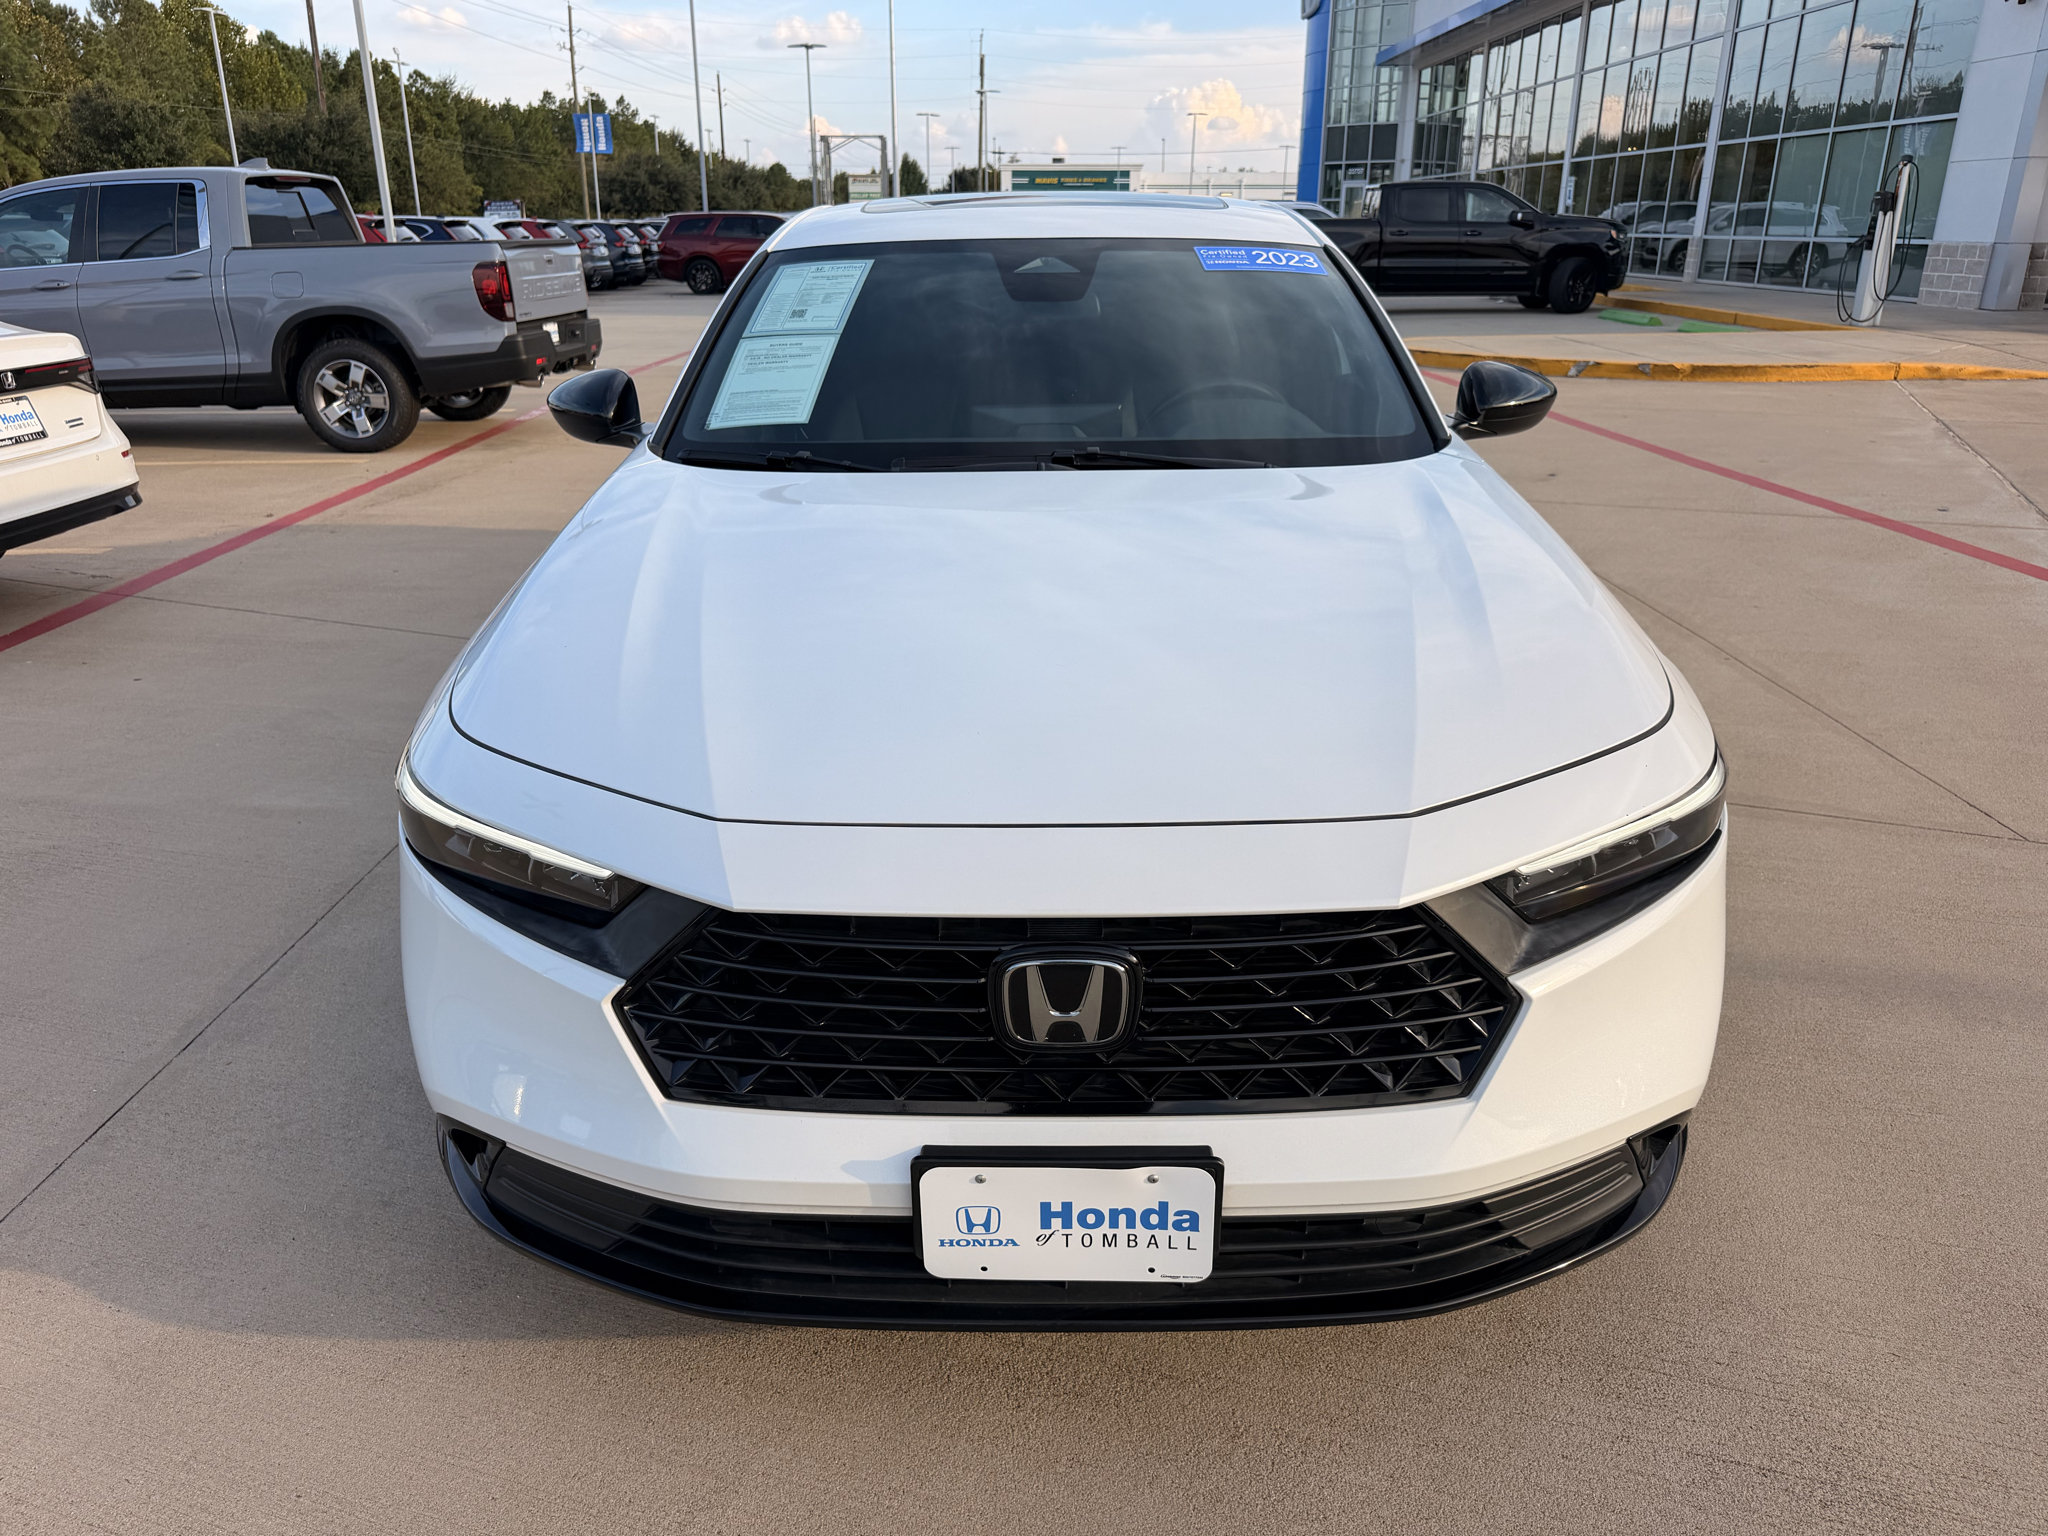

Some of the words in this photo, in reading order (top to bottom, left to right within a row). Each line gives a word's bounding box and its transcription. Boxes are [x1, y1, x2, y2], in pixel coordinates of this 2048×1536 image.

[581, 118, 591, 152] Honda
[596, 116, 606, 150] Honda
[1252, 250, 1319, 268] 2023
[0, 410, 34, 425] Honda
[10, 420, 38, 431] TOMBALL
[16, 432, 44, 443] TOMBALL
[1040, 1201, 1200, 1232] Honda
[938, 1238, 1021, 1247] HONDA
[1035, 1229, 1060, 1246] of
[1061, 1233, 1198, 1250] TOMBALL
